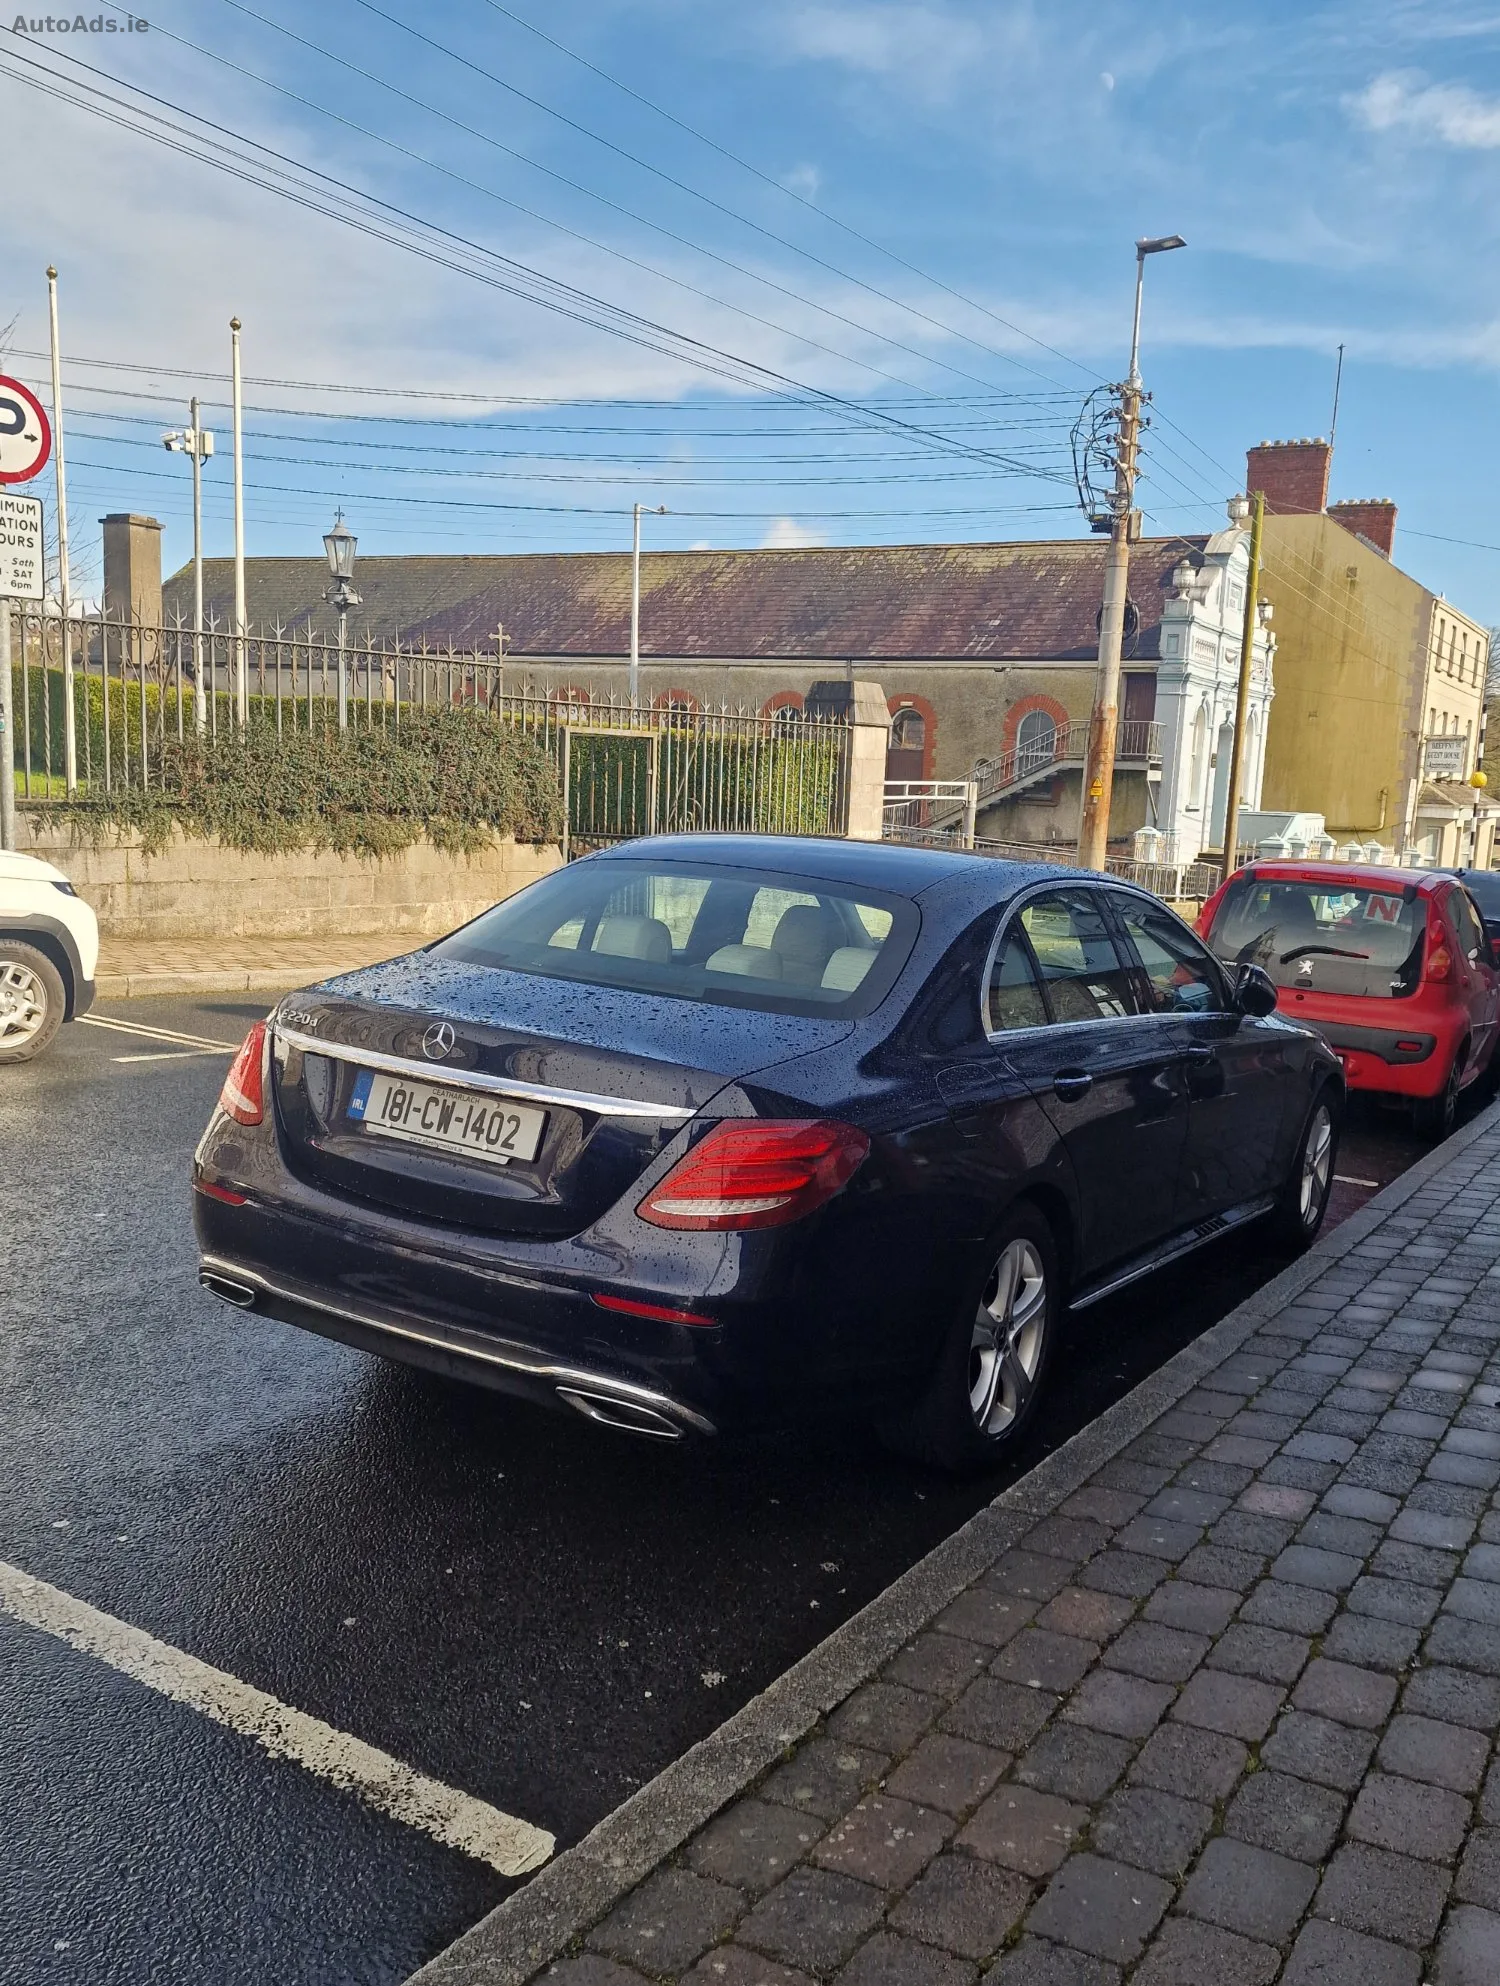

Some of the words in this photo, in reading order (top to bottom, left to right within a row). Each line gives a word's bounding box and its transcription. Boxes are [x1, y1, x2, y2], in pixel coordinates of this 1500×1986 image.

[11, 557, 35, 567] Sath
[13, 569, 33, 579] SAT
[10, 579, 32, 590] 6pm
[1367, 897, 1400, 922] N
[1388, 981, 1407, 989] 107
[280, 1008, 318, 1027] E220d
[432, 1087, 481, 1105] CEATHARLACH
[352, 1098, 365, 1110] IRL
[380, 1086, 521, 1150] 181-CW-1402
